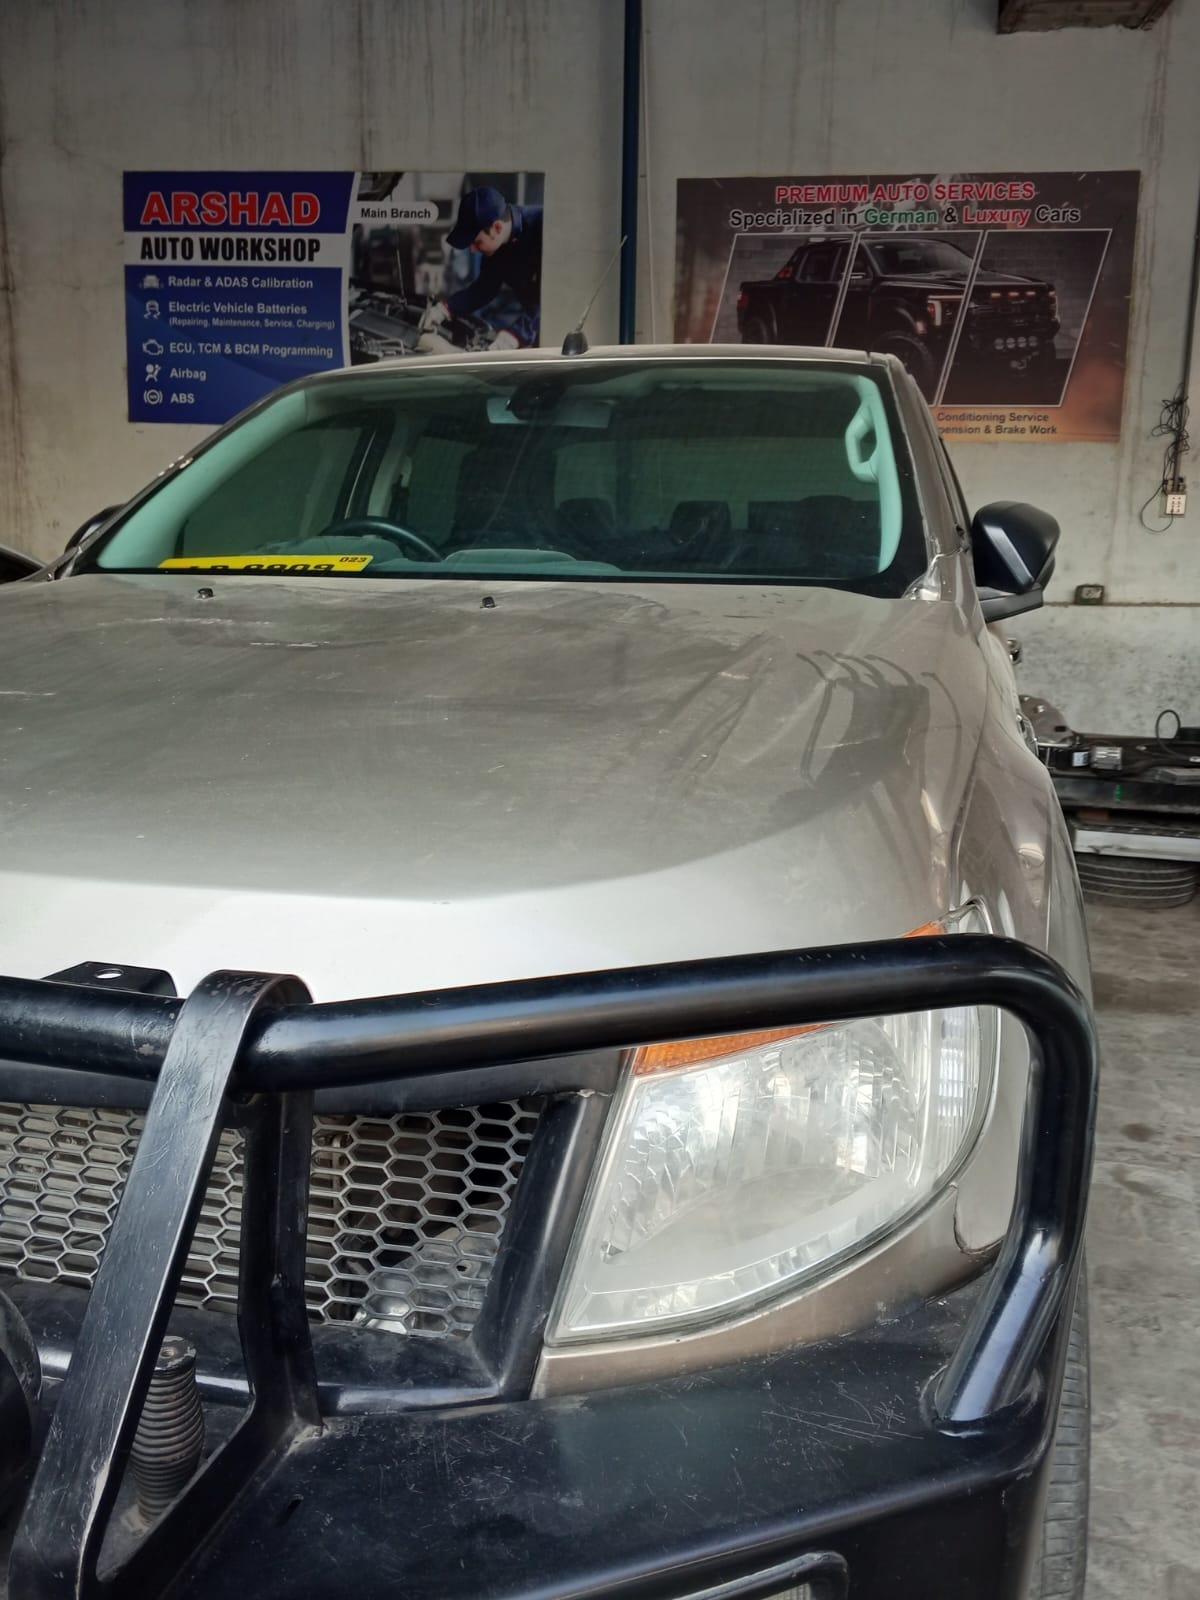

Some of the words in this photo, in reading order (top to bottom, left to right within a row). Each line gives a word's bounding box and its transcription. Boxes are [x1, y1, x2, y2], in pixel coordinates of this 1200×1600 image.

[776, 185, 869, 203] PREMIUM
[873, 183, 928, 202] AUTO
[934, 181, 1036, 201] SERVICES
[140, 191, 321, 226] ARSHAD
[361, 207, 387, 218] Main
[391, 208, 431, 218] Branch
[730, 209, 835, 231] Specialized
[841, 209, 857, 225] in
[863, 207, 938, 225] German
[944, 207, 957, 223] &
[963, 205, 1031, 228] Luxury
[1036, 205, 1081, 223] Cars
[140, 237, 194, 260] AUTO
[199, 238, 321, 262] WORKSHOP
[168, 276, 200, 287] Radar
[204, 277, 213, 287] &
[215, 277, 248, 288] ADAS
[251, 277, 313, 289] Calibration
[168, 302, 210, 313] Electric
[213, 302, 254, 313] Vehicle
[257, 303, 307, 314] Batteries
[297, 319, 335, 330] Charging)
[170, 343, 195, 354] ECU,
[198, 343, 222, 354] TCM
[224, 344, 232, 354] &
[235, 344, 260, 355] BCM
[262, 345, 334, 358] Programming
[170, 368, 207, 381] Airbag
[170, 393, 195, 404] ABS
[937, 412, 1006, 423] Conditioning
[1009, 412, 1049, 422] Service
[984, 425, 991, 434] &
[995, 425, 1026, 434] Brake
[1030, 425, 1057, 434] Work
